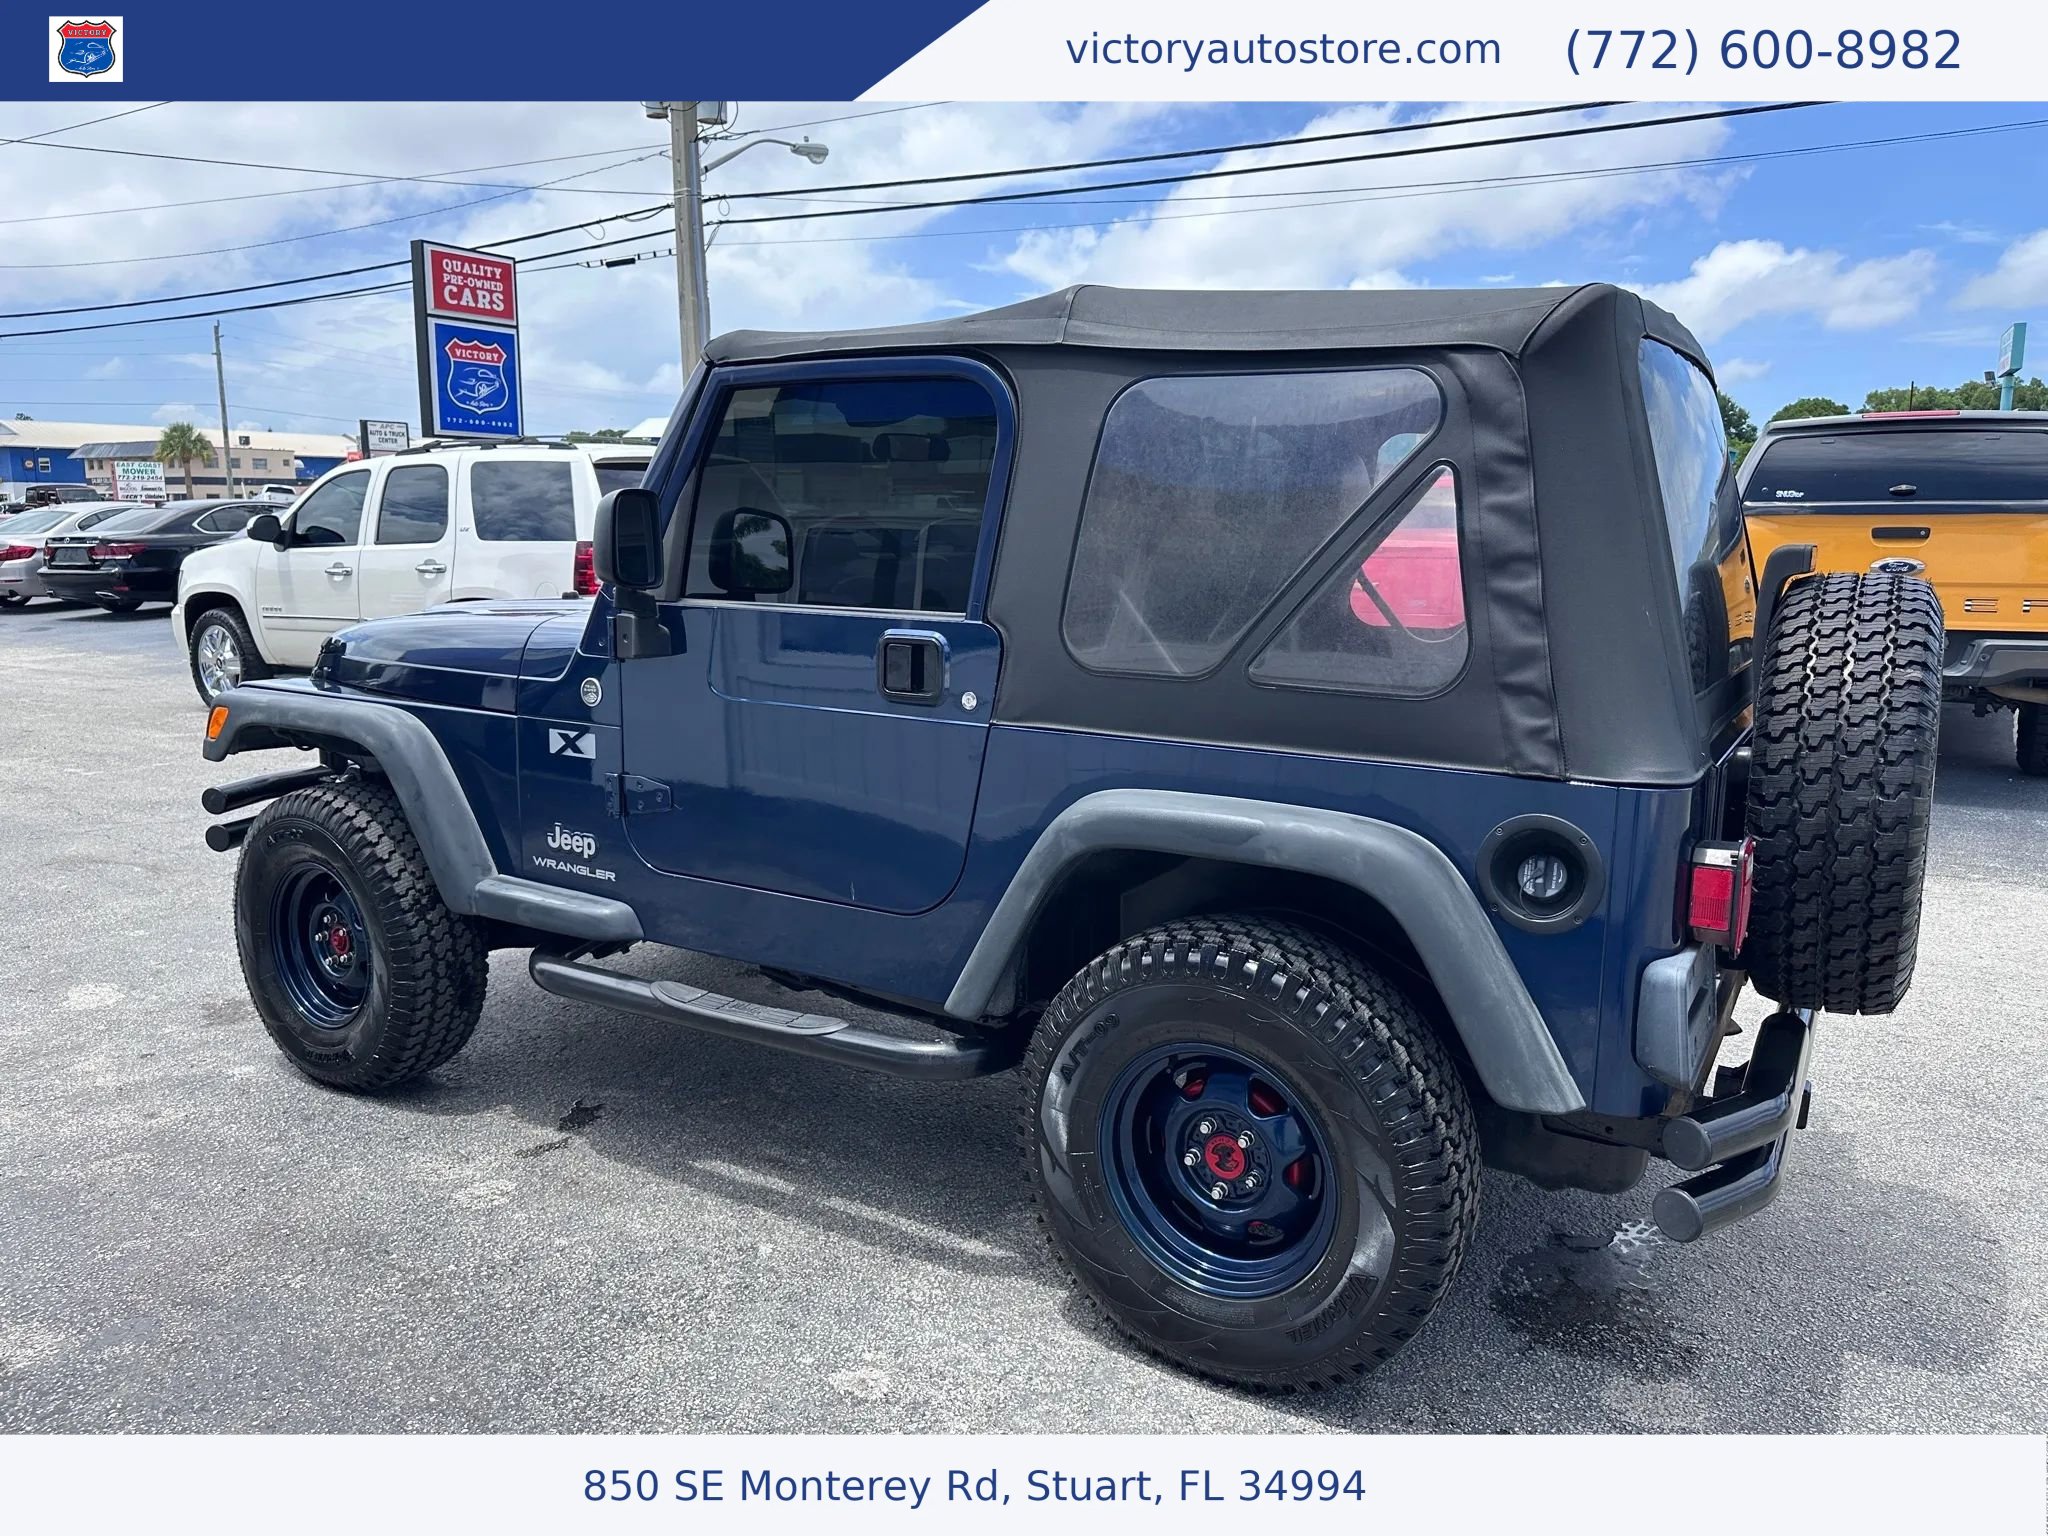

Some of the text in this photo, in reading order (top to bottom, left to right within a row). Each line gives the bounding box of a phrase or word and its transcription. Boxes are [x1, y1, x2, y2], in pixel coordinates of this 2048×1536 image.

[443, 259, 502, 279] QUALITY
[443, 273, 503, 291] PRE-OWNED
[444, 285, 504, 311] CARS
[455, 348, 498, 361] VICTORY
[1886, 562, 1910, 572] Ford
[552, 727, 592, 757] X
[547, 822, 596, 859] Jeep
[533, 855, 616, 882] WRANGLER
